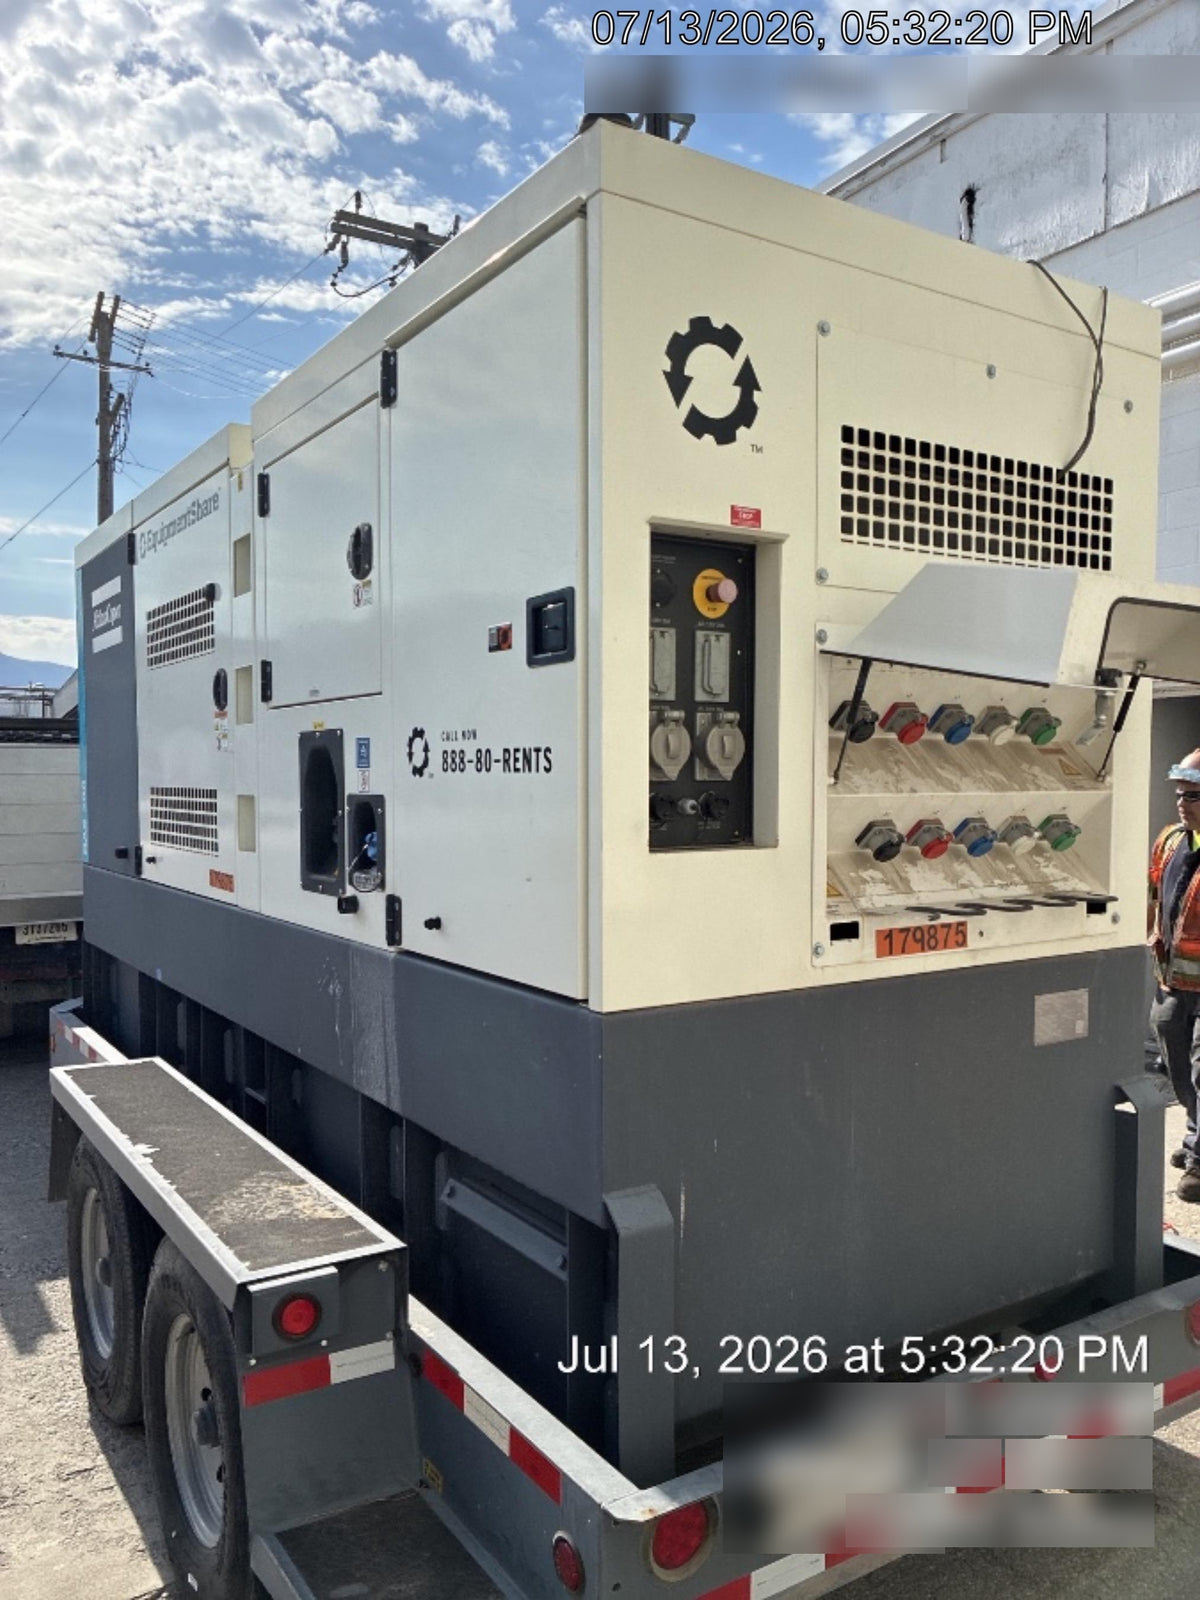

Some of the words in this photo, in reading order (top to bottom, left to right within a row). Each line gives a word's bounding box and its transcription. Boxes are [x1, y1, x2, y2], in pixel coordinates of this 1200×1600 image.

[441, 730, 458, 742] CALL
[461, 729, 478, 741] NOW
[442, 746, 552, 774] 888-80-RENTS
[883, 921, 967, 955] 179875
